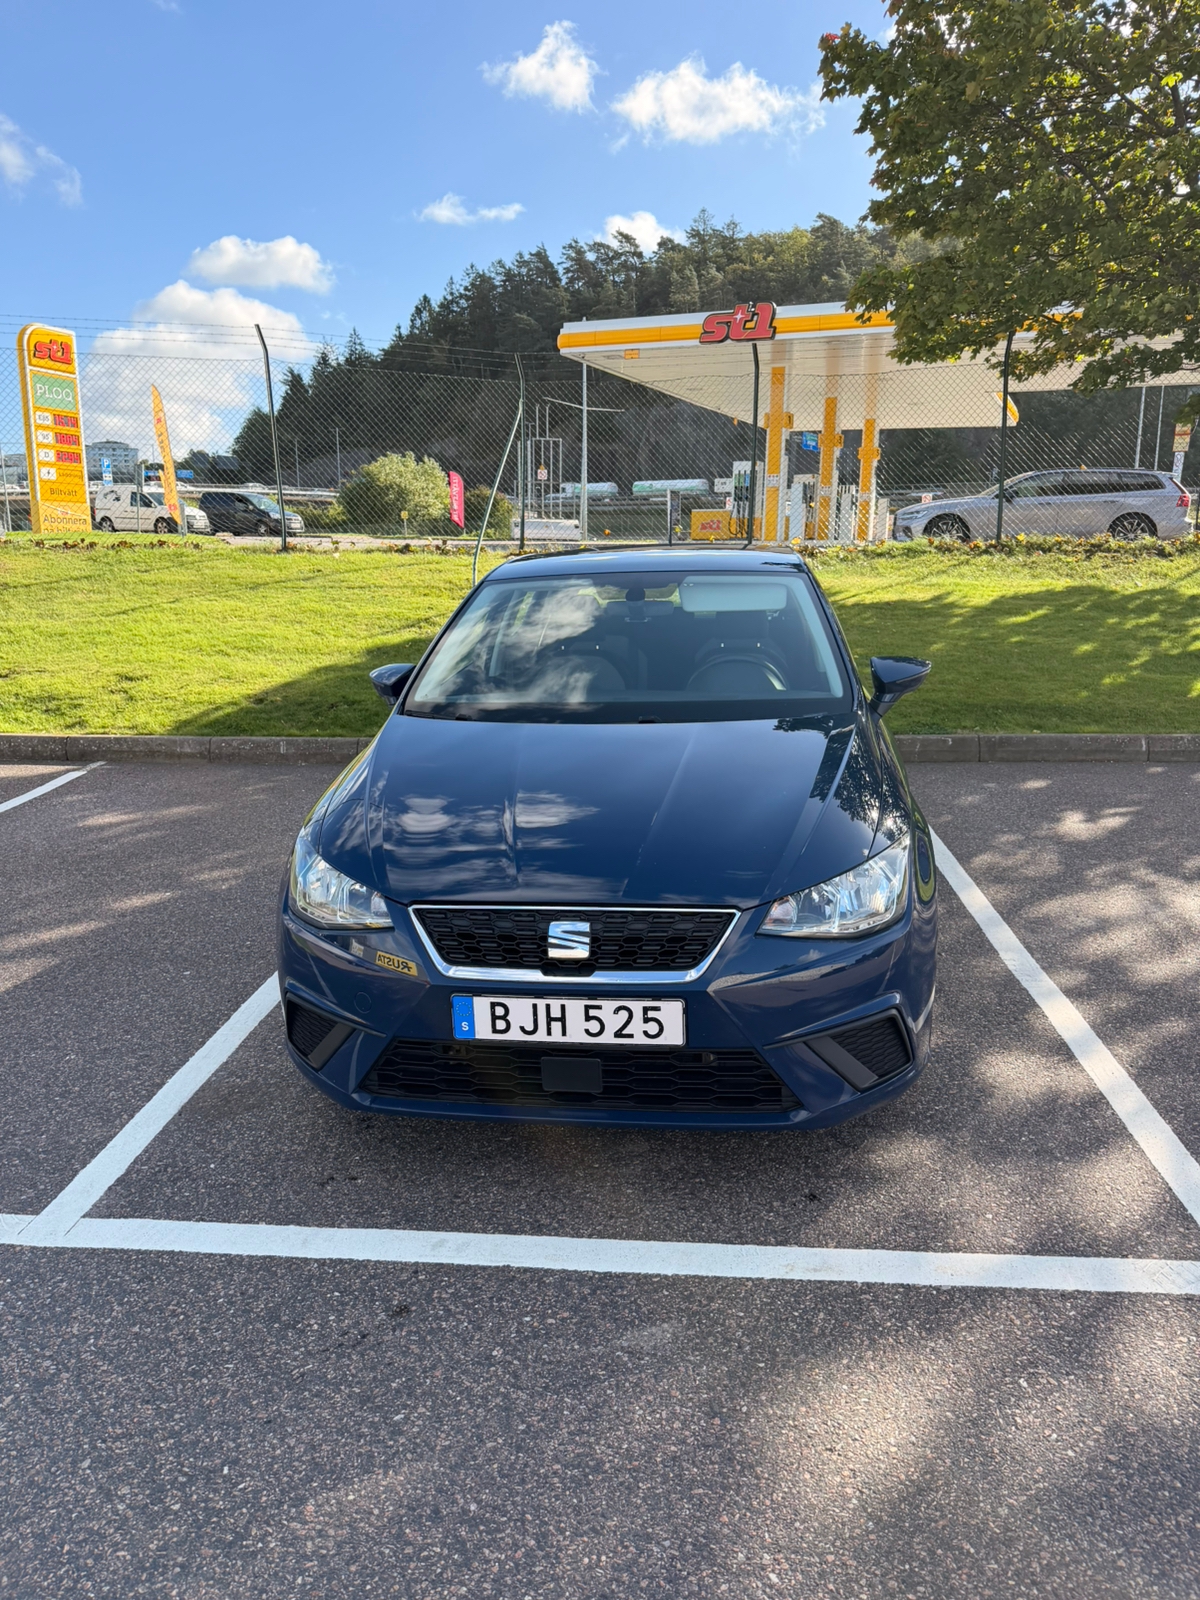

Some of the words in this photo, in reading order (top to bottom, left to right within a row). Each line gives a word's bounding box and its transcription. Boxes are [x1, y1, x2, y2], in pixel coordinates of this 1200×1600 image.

[700, 302, 776, 342] st1
[34, 339, 72, 365] st1
[36, 383, 73, 402] PLOQ
[50, 487, 78, 497] Biltvätt
[43, 514, 87, 525] Abonnera
[461, 1021, 470, 1031] S
[489, 1001, 567, 1037] BJH
[583, 1004, 665, 1039] 525
